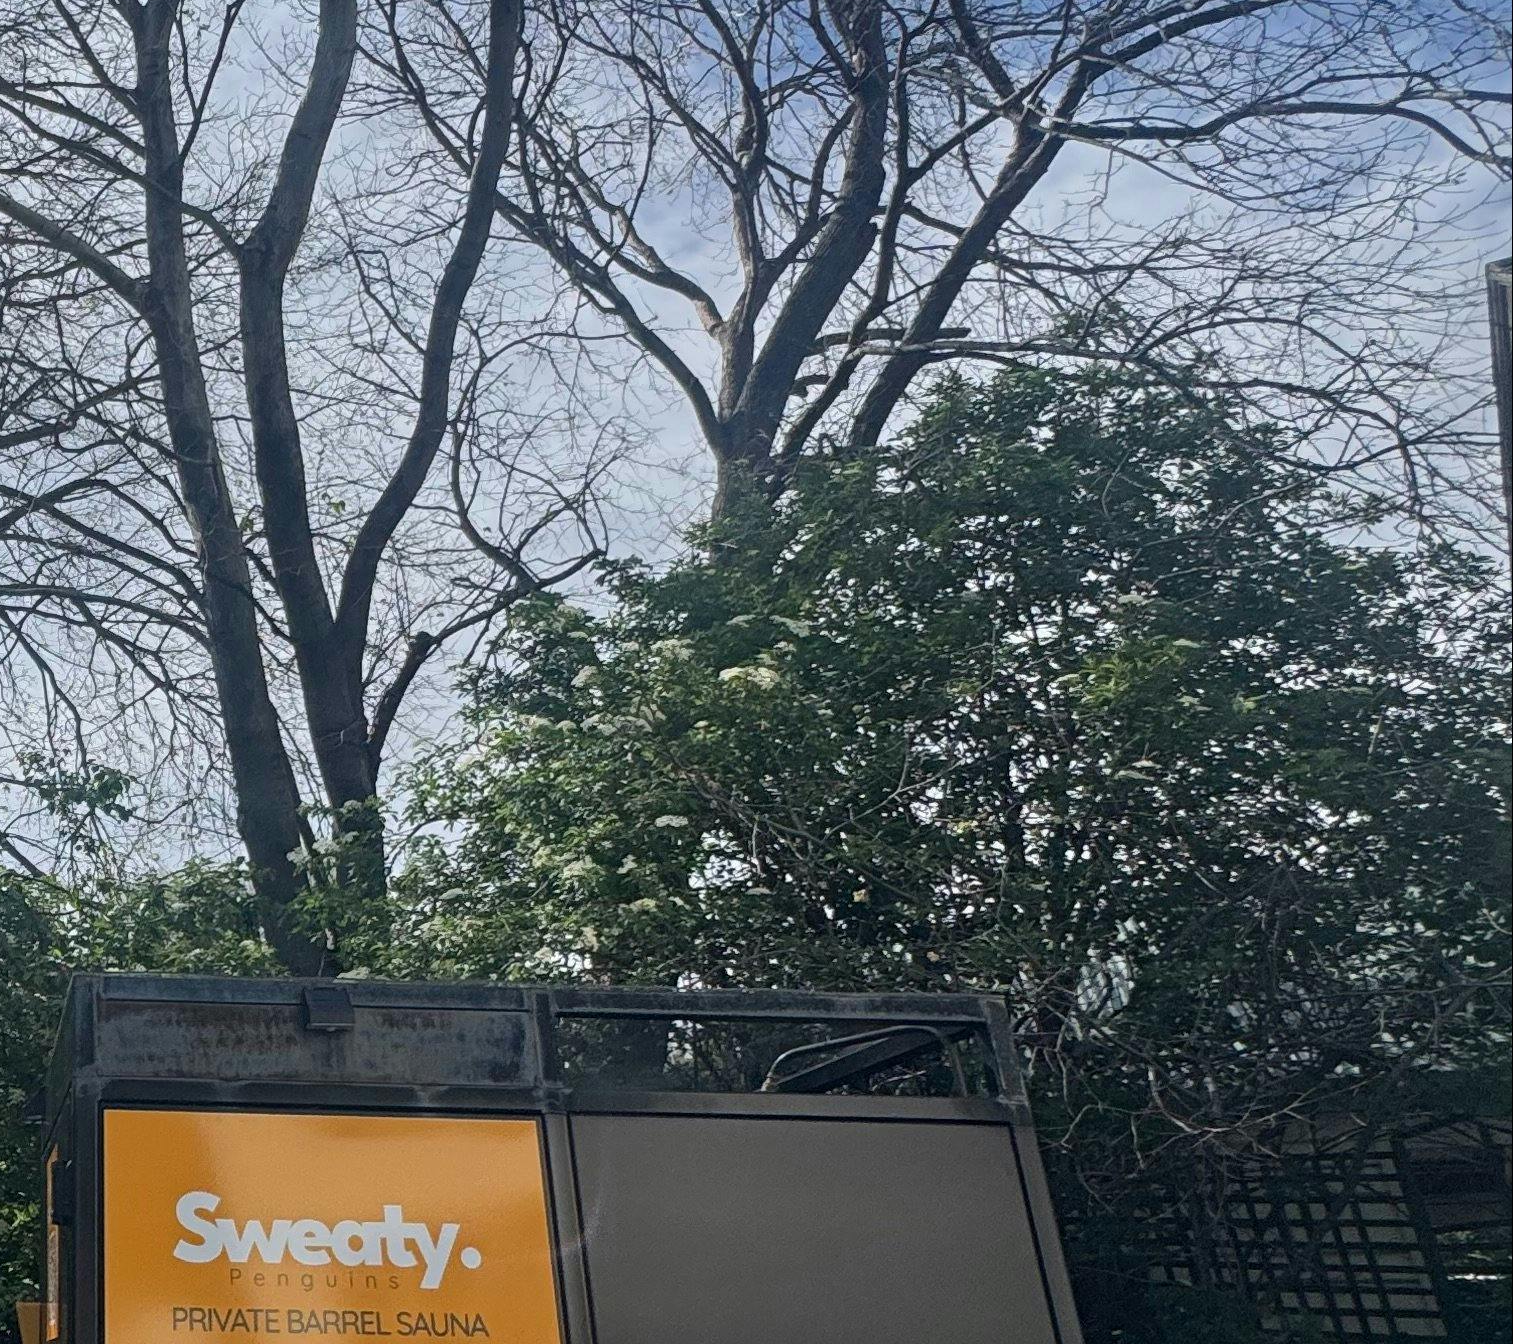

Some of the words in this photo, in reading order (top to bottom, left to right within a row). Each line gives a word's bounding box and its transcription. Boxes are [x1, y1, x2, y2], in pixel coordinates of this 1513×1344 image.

[173, 1191, 482, 1290] Sweaty.
[230, 1268, 400, 1291] Penguins
[172, 1306, 280, 1333] PRIVATE
[288, 1309, 392, 1336] BARREL
[397, 1311, 490, 1338] SAUNA
